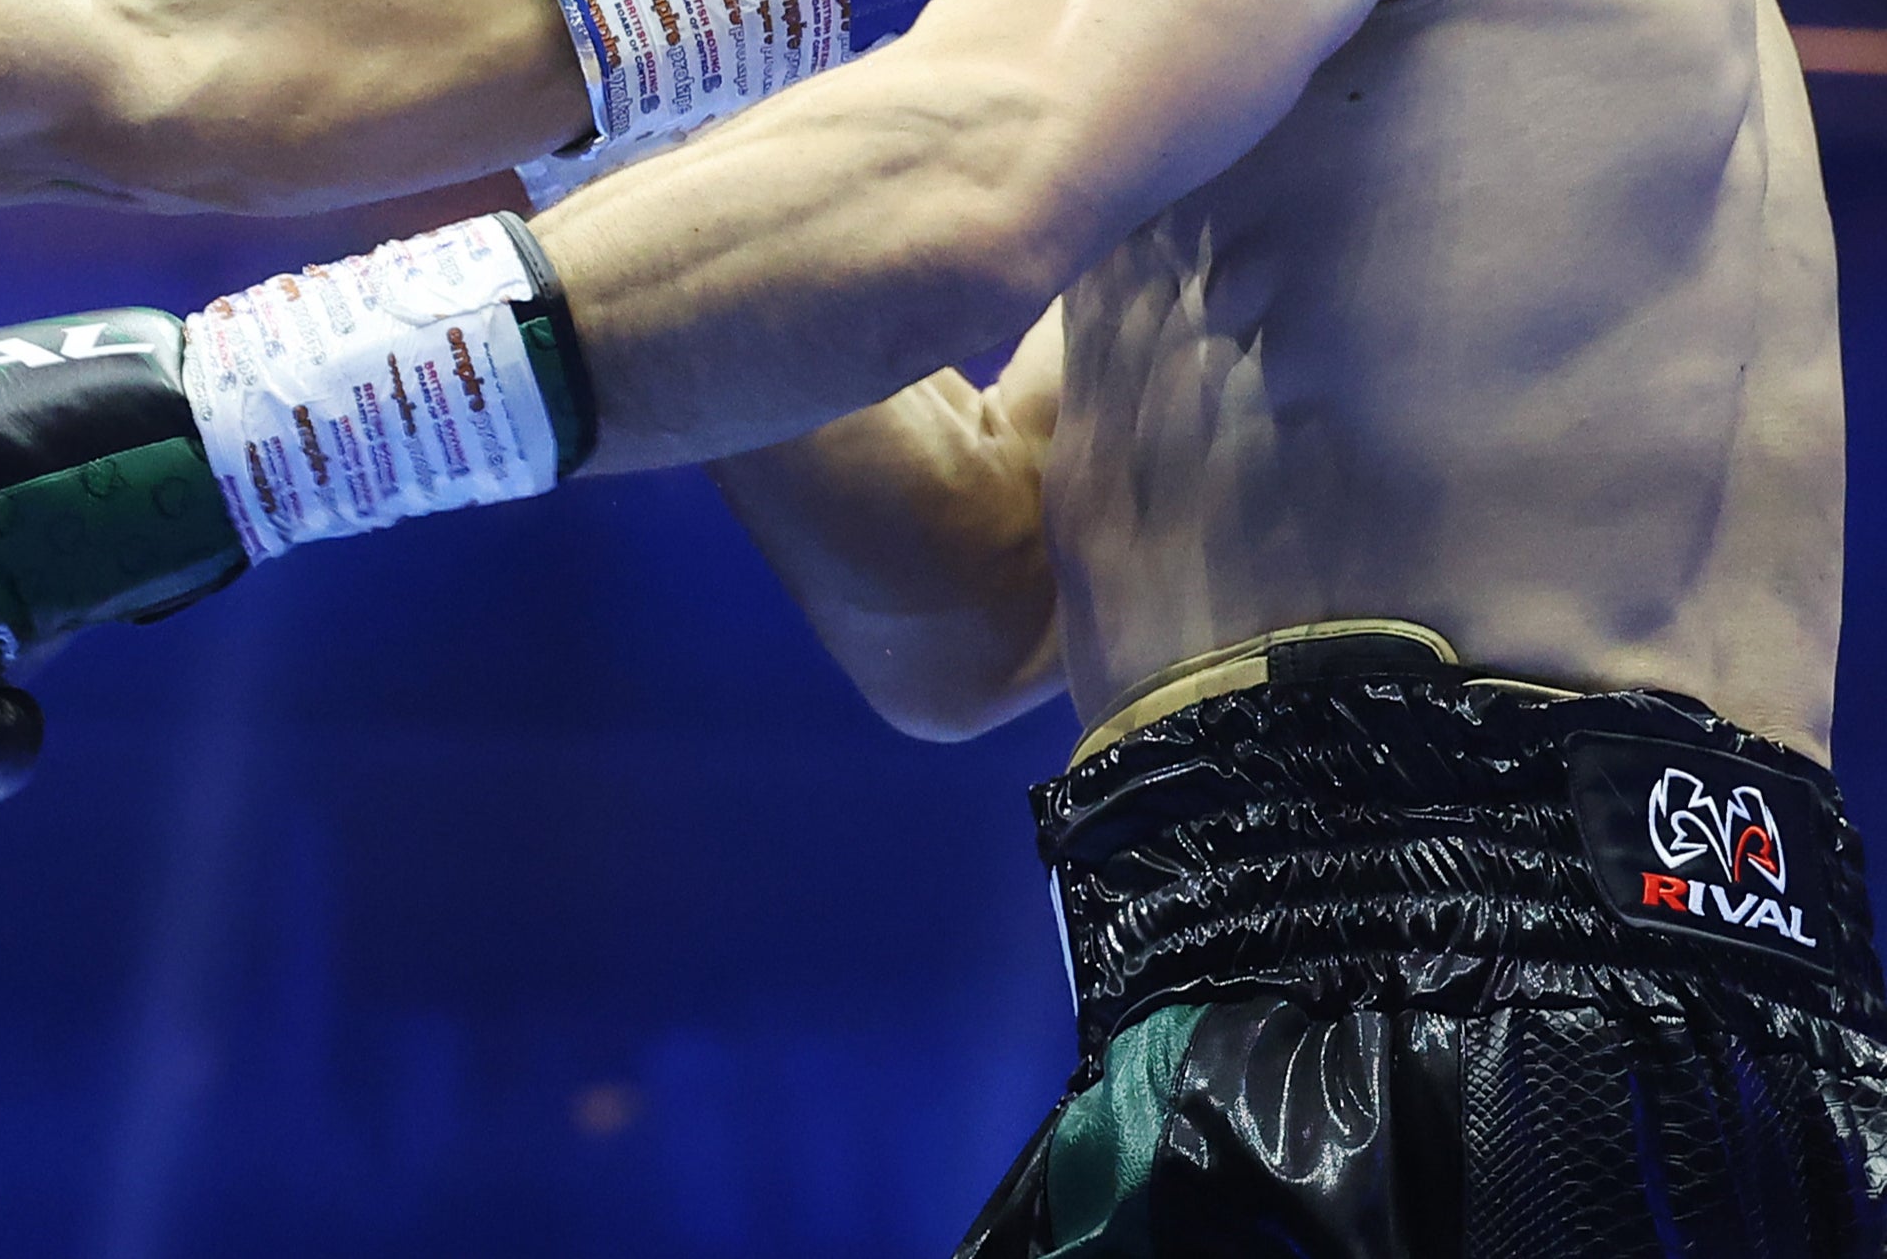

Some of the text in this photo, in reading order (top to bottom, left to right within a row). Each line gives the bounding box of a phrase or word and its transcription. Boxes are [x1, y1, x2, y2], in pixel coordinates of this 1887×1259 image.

[614, 2, 646, 96] BOARD OF CONTROL
[644, 51, 657, 93] BOXING
[689, 17, 698, 30] OF
[694, 33, 707, 77] CONTROL
[704, 29, 720, 73] BOXING
[666, 44, 693, 114] protape
[415, 365, 432, 403] BOARD
[424, 360, 448, 415] BRITISH
[447, 327, 485, 412] empire
[1640, 872, 1816, 947] RIVAL
